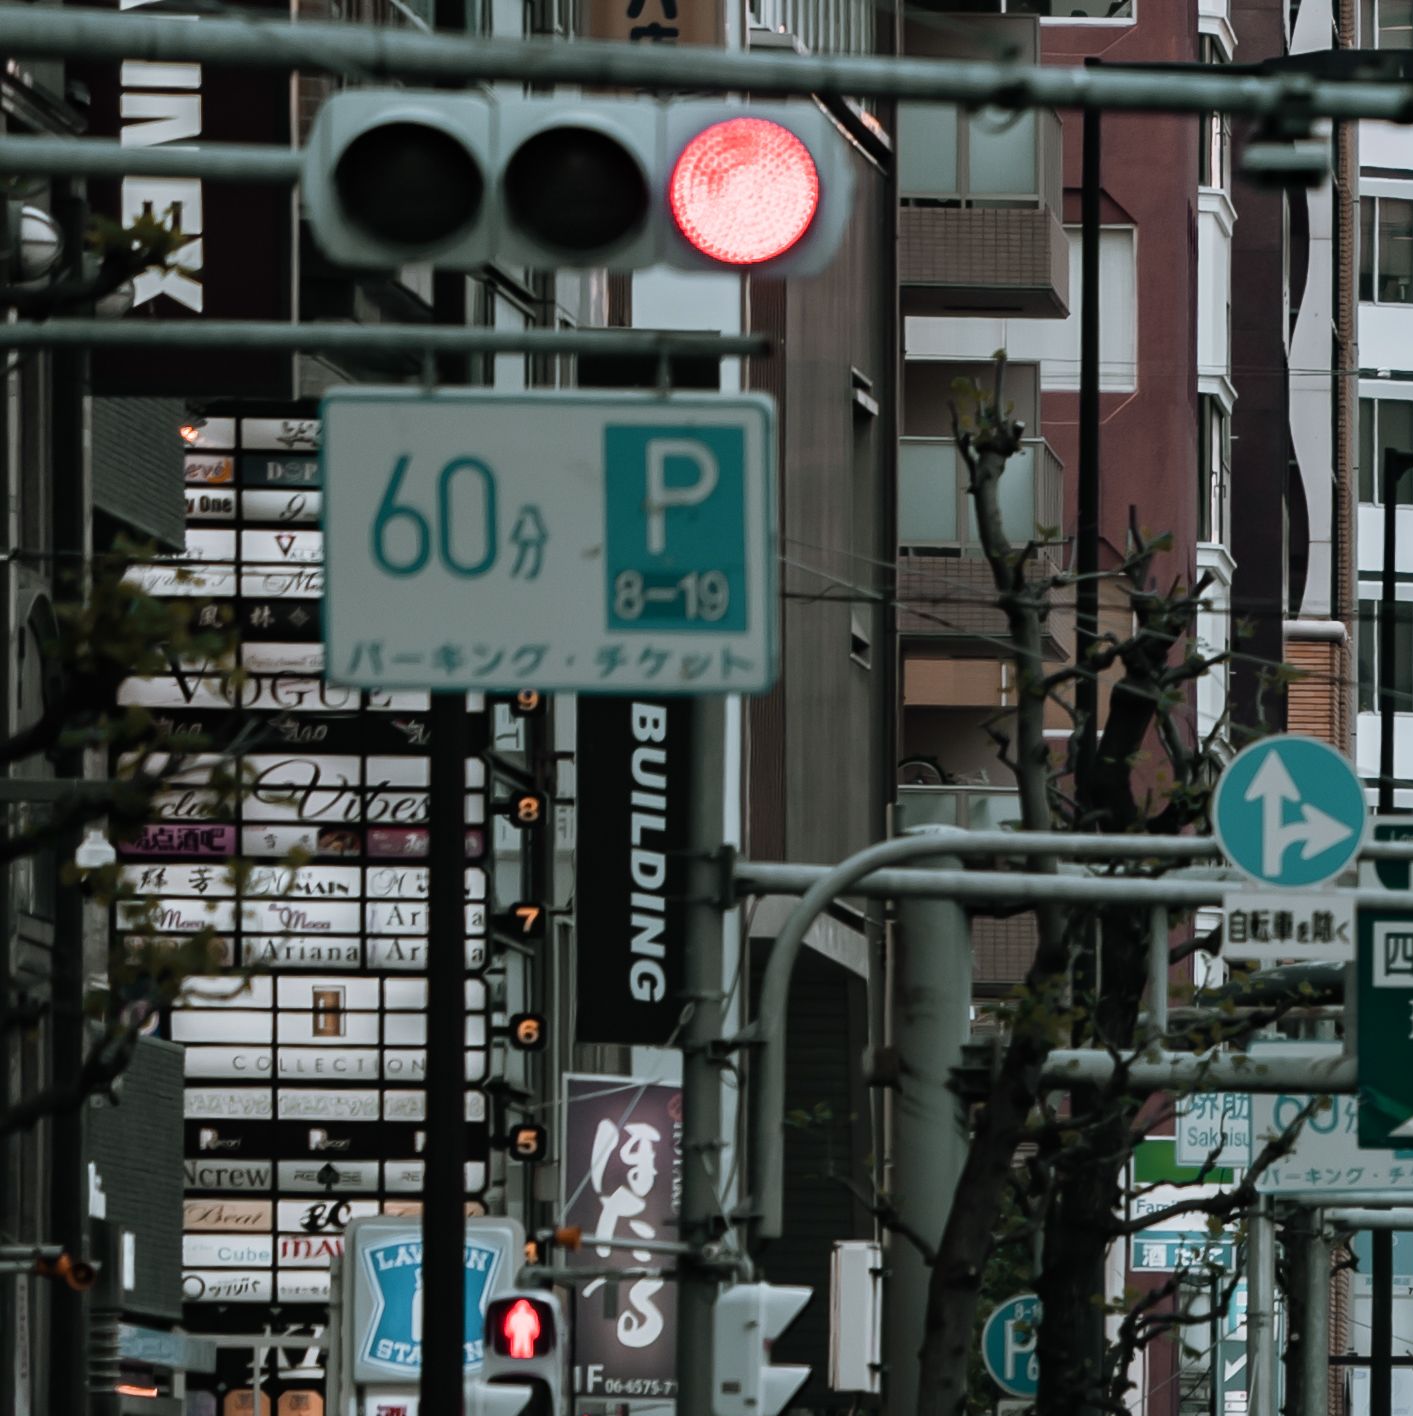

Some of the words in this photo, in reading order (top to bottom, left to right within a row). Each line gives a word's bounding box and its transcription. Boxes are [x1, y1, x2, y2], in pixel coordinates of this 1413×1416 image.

[199, 495, 233, 513] One
[645, 437, 721, 556] P
[370, 452, 550, 581] 60分
[615, 569, 730, 621] 8-19
[346, 637, 753, 680] パーキング・チケット
[518, 797, 539, 821] 8
[629, 702, 668, 1003] BUILDING
[516, 906, 539, 932] 7
[1229, 909, 1350, 945] 自転車を除く
[518, 1018, 540, 1043] 6
[516, 1129, 538, 1155] 5
